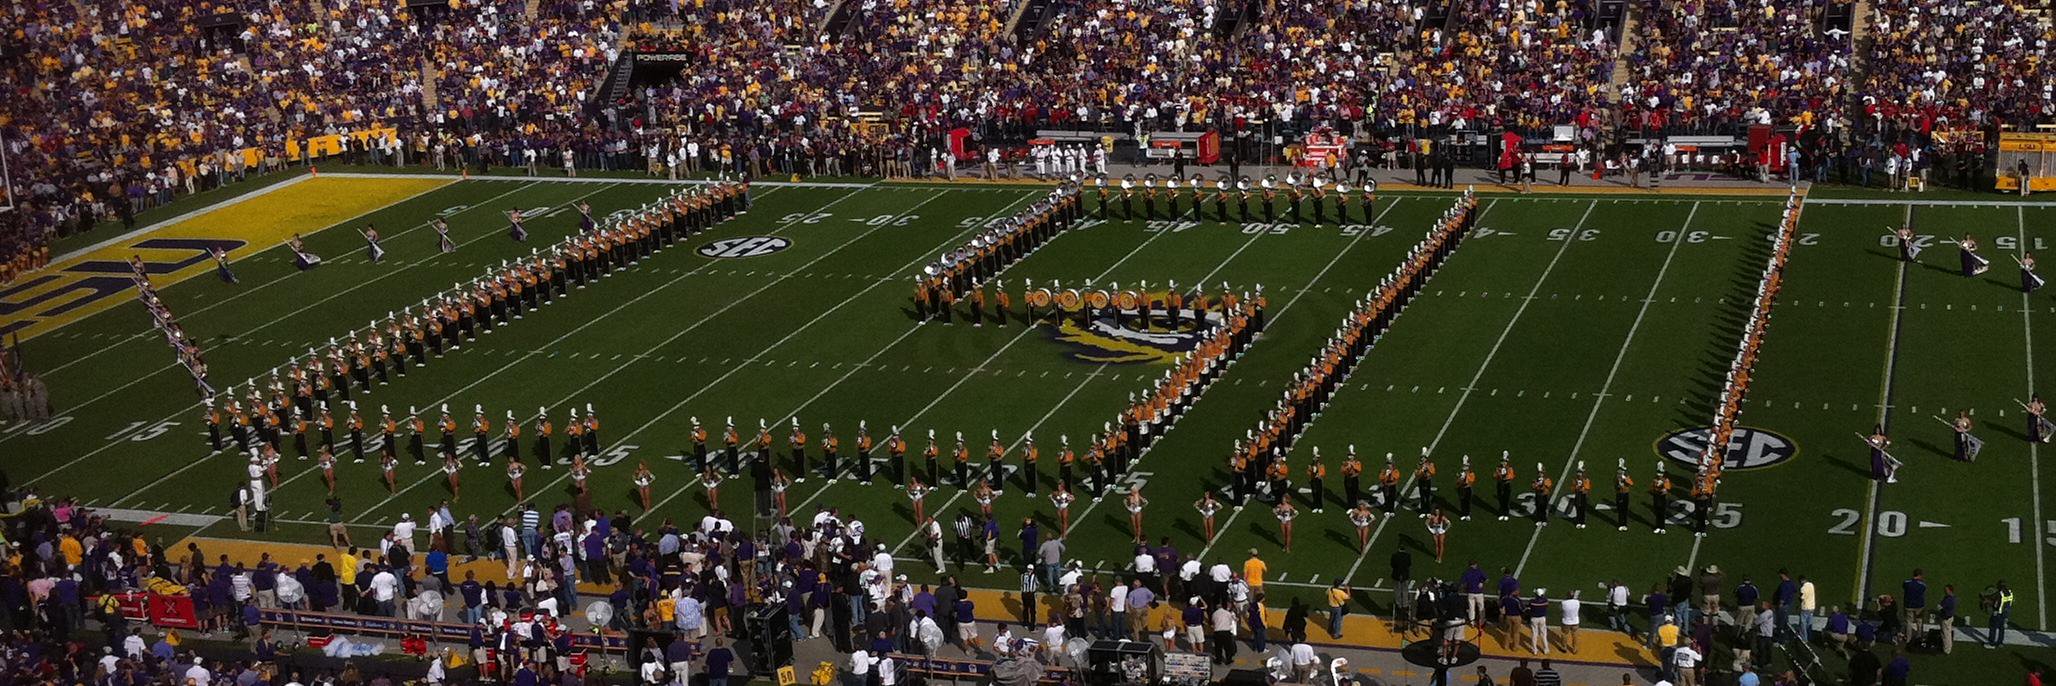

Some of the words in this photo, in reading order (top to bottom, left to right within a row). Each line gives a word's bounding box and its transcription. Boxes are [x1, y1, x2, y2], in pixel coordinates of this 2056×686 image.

[776, 212, 833, 225] 25
[1241, 221, 1291, 235] 50
[1339, 223, 1391, 237] 45
[1546, 228, 1600, 241] 35
[1655, 231, 1709, 243] 30
[1996, 235, 2049, 250] 15
[700, 236, 787, 258] SEC
[104, 420, 182, 442] 15
[1664, 499, 1744, 529] 25
[1827, 507, 1908, 538] 20
[780, 670, 793, 684] 50
